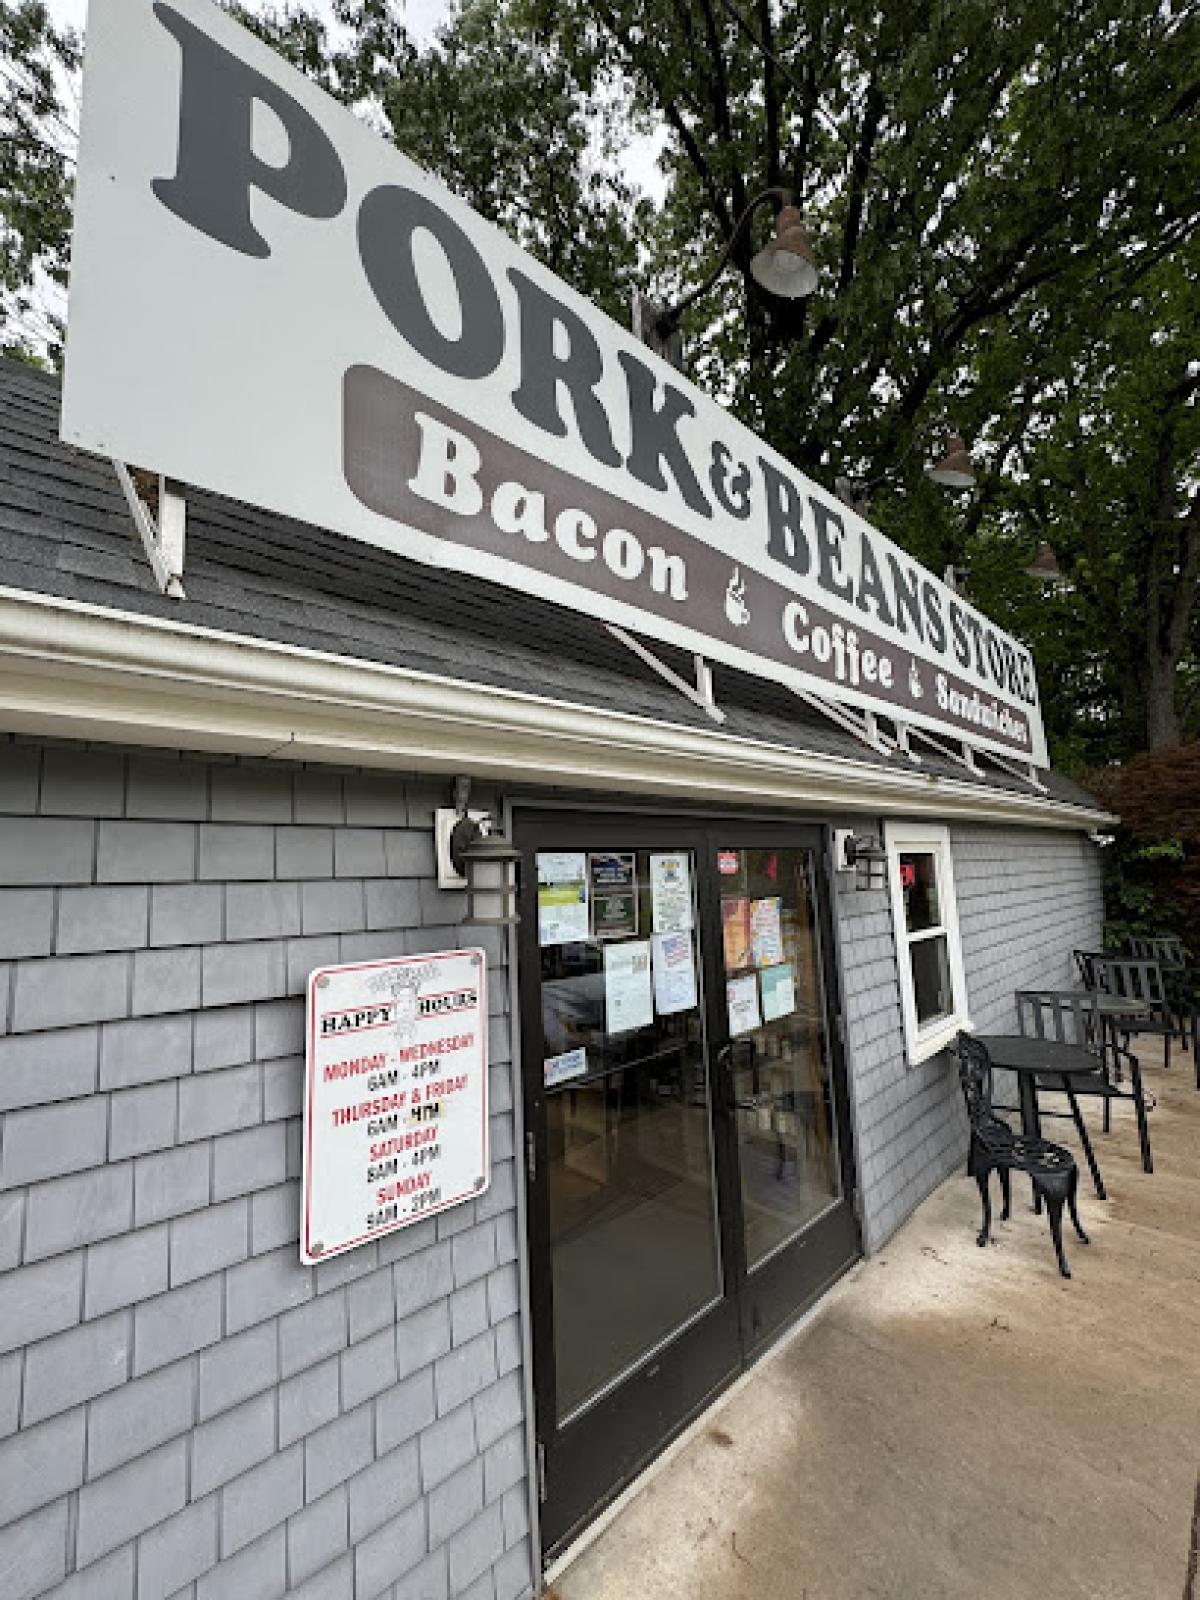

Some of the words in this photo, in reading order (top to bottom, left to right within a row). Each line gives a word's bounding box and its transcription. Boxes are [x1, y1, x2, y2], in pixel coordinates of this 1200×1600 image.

[150, 2, 713, 520] PORK
[709, 440, 751, 520] &
[758, 455, 948, 654] BEANS
[949, 599, 1037, 707] STORE
[408, 410, 689, 602] Bacon
[782, 601, 895, 688] Coffee
[321, 1006, 391, 1033] HAPPY
[419, 991, 478, 1014] HOURS
[323, 1053, 388, 1083] MONDAY
[399, 1032, 475, 1063] WEDNESDAY
[367, 1069, 398, 1092] 6AM
[411, 1058, 440, 1080] 4PM
[332, 1092, 407, 1128] THURSDAY
[411, 1087, 421, 1104] &
[426, 1073, 468, 1103] FRIDAY
[370, 1124, 439, 1162] SATURDAY
[376, 1170, 432, 1206] SUNDAY
